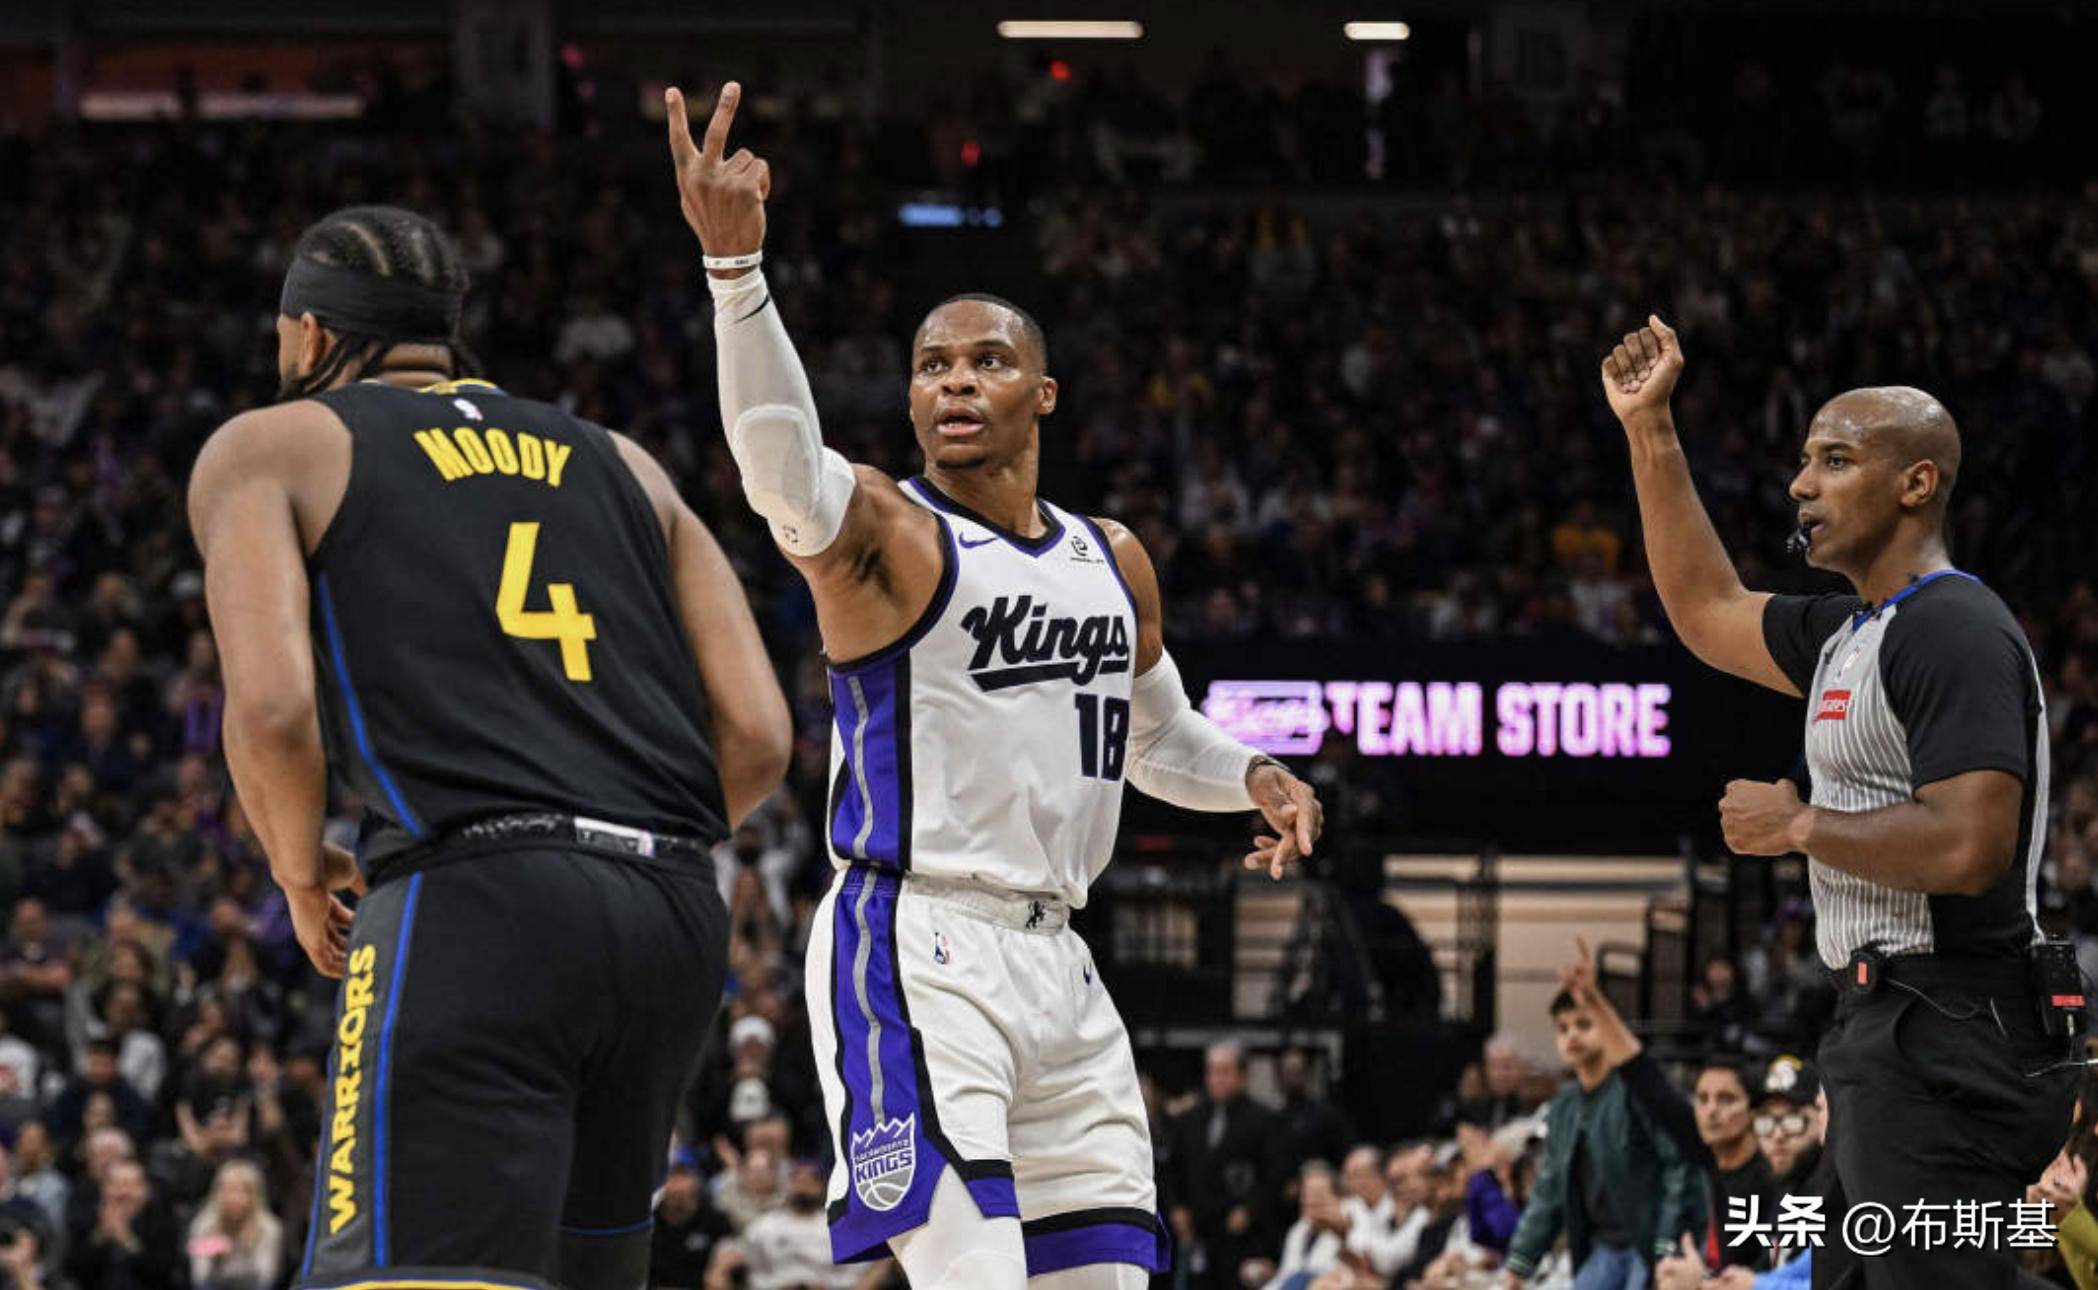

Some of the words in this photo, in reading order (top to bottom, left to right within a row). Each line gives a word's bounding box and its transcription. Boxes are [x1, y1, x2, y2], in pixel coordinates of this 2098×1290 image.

[413, 427, 572, 487] MOODY
[496, 521, 596, 681] 4
[961, 594, 1130, 687] Kings
[1074, 693, 1130, 781] 18
[1325, 680, 1484, 757] TEAM
[1496, 683, 1674, 758] STORE
[329, 944, 376, 1234] WARRIORS
[855, 1149, 913, 1184] KINGS
